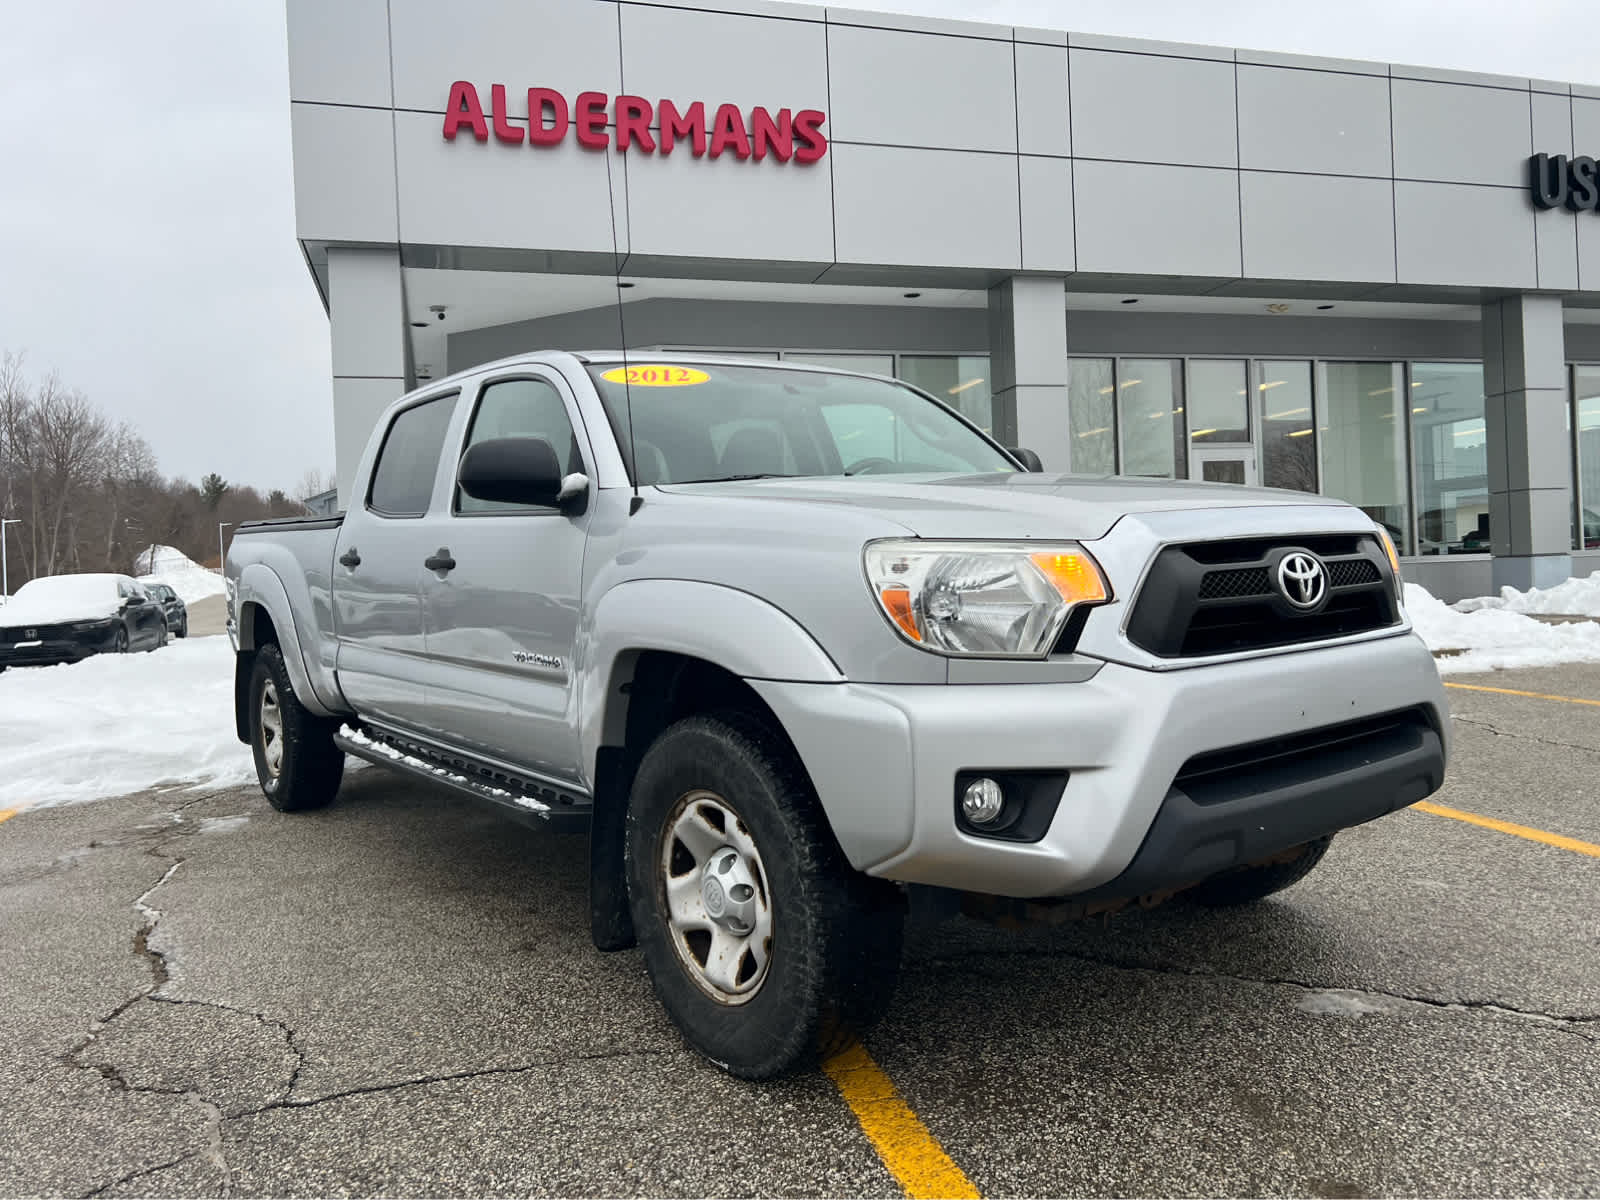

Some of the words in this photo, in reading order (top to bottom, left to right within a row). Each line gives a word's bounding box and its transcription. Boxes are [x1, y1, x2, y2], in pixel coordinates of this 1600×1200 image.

[443, 80, 828, 164] ALDERMANS
[1528, 152, 1600, 212] US
[626, 369, 690, 383] 2012
